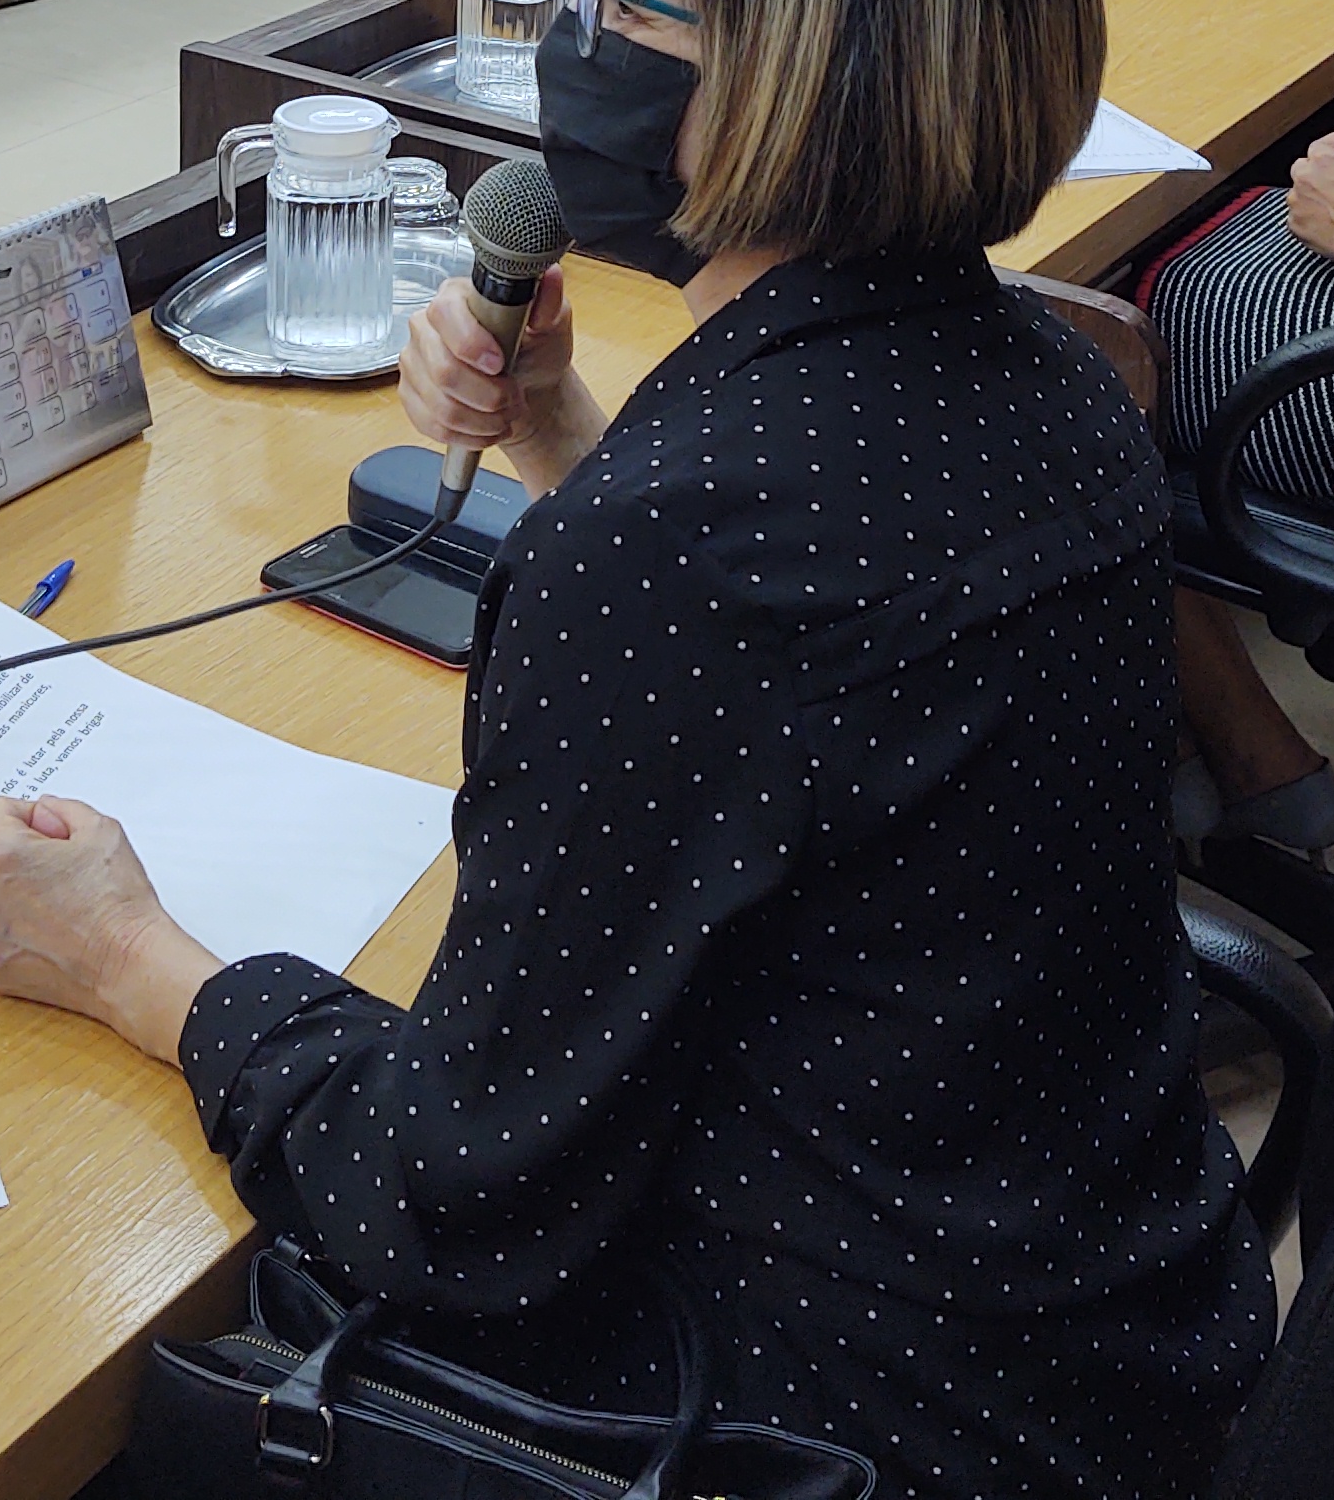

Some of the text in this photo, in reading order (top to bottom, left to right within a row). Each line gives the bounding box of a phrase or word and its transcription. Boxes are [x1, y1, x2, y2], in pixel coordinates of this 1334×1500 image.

[7, 683, 52, 724] manicures,
[19, 672, 34, 684] de
[0, 777, 19, 794] nós
[15, 767, 27, 776] é
[22, 746, 47, 768] lutar
[45, 727, 66, 747] pela
[63, 702, 89, 726] nossa
[25, 784, 38, 792] à
[32, 765, 59, 784] luta,
[54, 736, 83, 762] vamos
[77, 710, 105, 736] brigar
